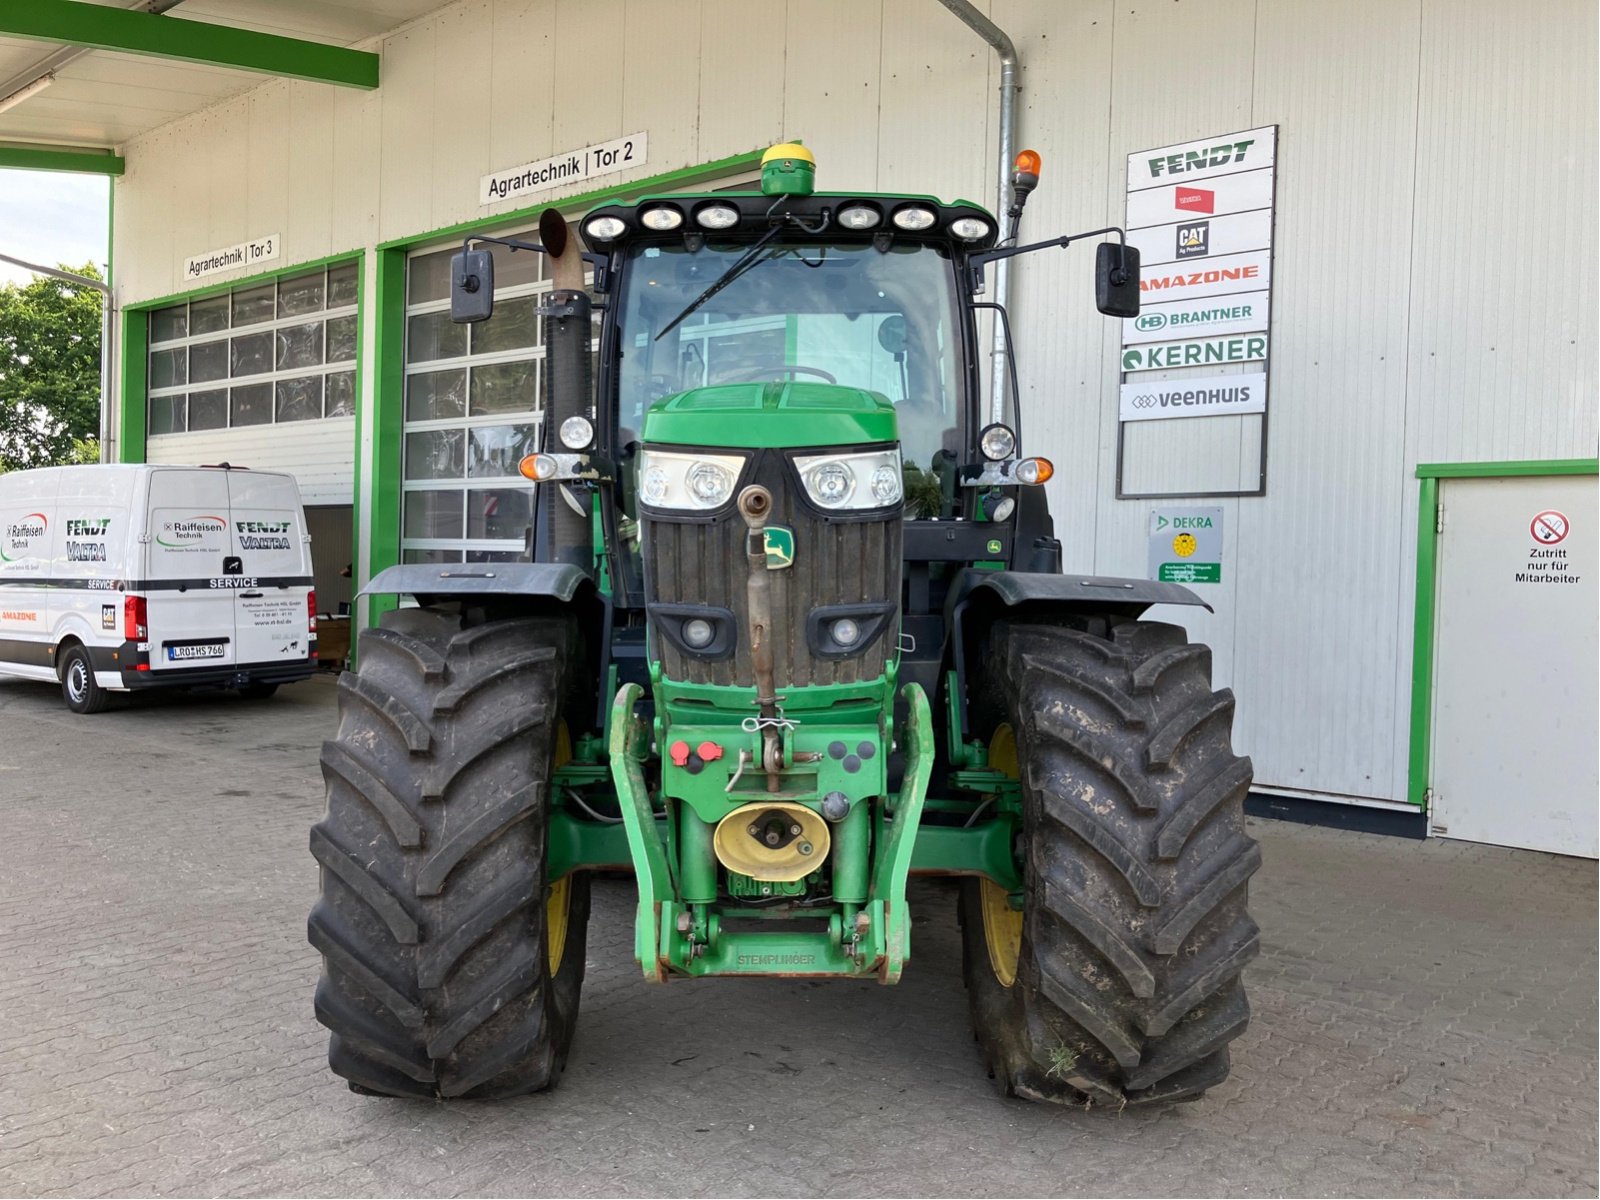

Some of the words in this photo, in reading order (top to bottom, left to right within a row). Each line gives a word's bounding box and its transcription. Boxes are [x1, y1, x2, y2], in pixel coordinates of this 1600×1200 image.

[1148, 140, 1255, 178] FENDT
[488, 156, 580, 198] Agrartechnik
[594, 149, 619, 168] Tor
[624, 142, 633, 161] 2
[1180, 226, 1206, 246] CAT
[189, 248, 242, 276] Agrartechnik
[250, 244, 264, 258] Tor
[267, 240, 272, 254] 3
[1170, 306, 1252, 326] BRANTNER
[1148, 338, 1265, 368] KERNER
[67, 519, 110, 536] FENDT
[174, 522, 222, 532] Raiffeisen
[236, 522, 291, 533] FENDT
[1174, 517, 1212, 528] DEKRA
[12, 525, 43, 537] Raiffeisen
[12, 539, 28, 549] Technik
[239, 536, 290, 550] VALTRA
[67, 541, 106, 561] VALTRA
[1530, 548, 1566, 558] Zutritt
[1552, 561, 1568, 570] für
[210, 578, 258, 588] SERVICE
[1515, 573, 1580, 583] Mitarbeiter
[88, 580, 114, 589] SERVICE
[2, 612, 36, 621] AMAZONE
[208, 646, 222, 654] 766
